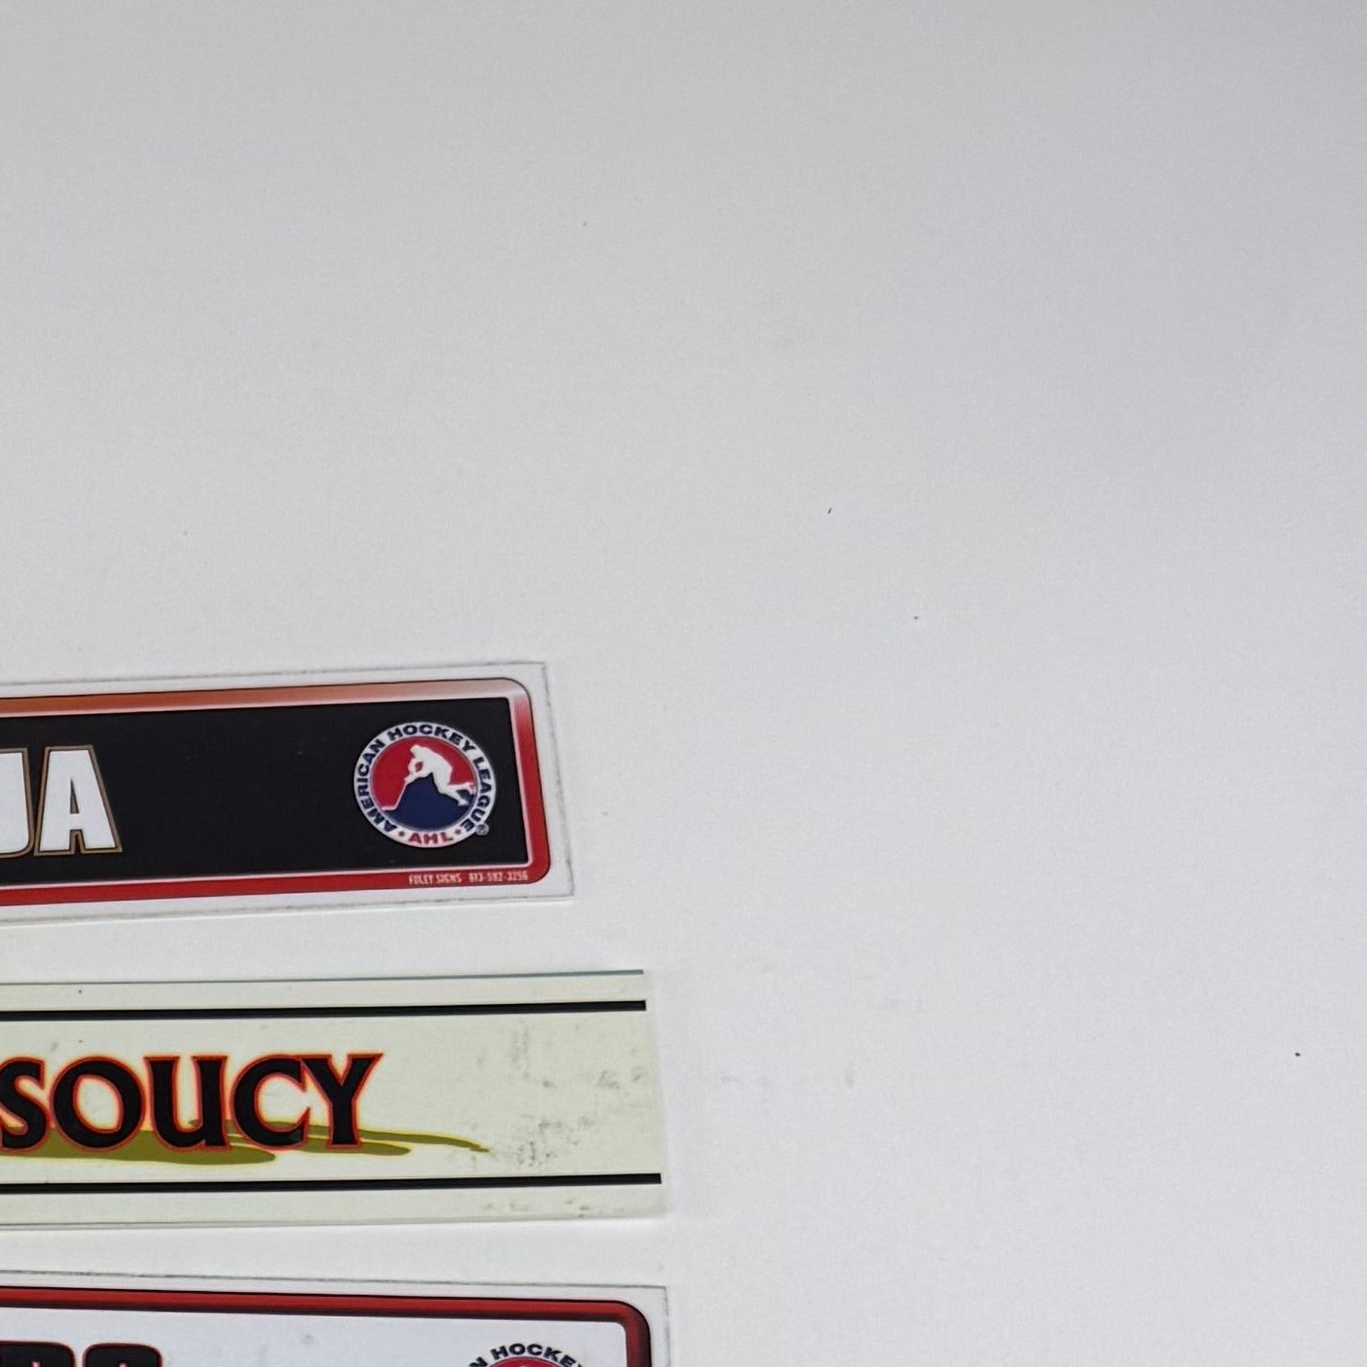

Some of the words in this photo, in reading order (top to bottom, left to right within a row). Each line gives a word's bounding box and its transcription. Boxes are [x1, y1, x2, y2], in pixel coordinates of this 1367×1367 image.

[356, 740, 394, 833] AMERICAN
[388, 724, 476, 753] HOCKEY
[464, 756, 492, 833] LEAGUE
[409, 832, 453, 844] AHL
